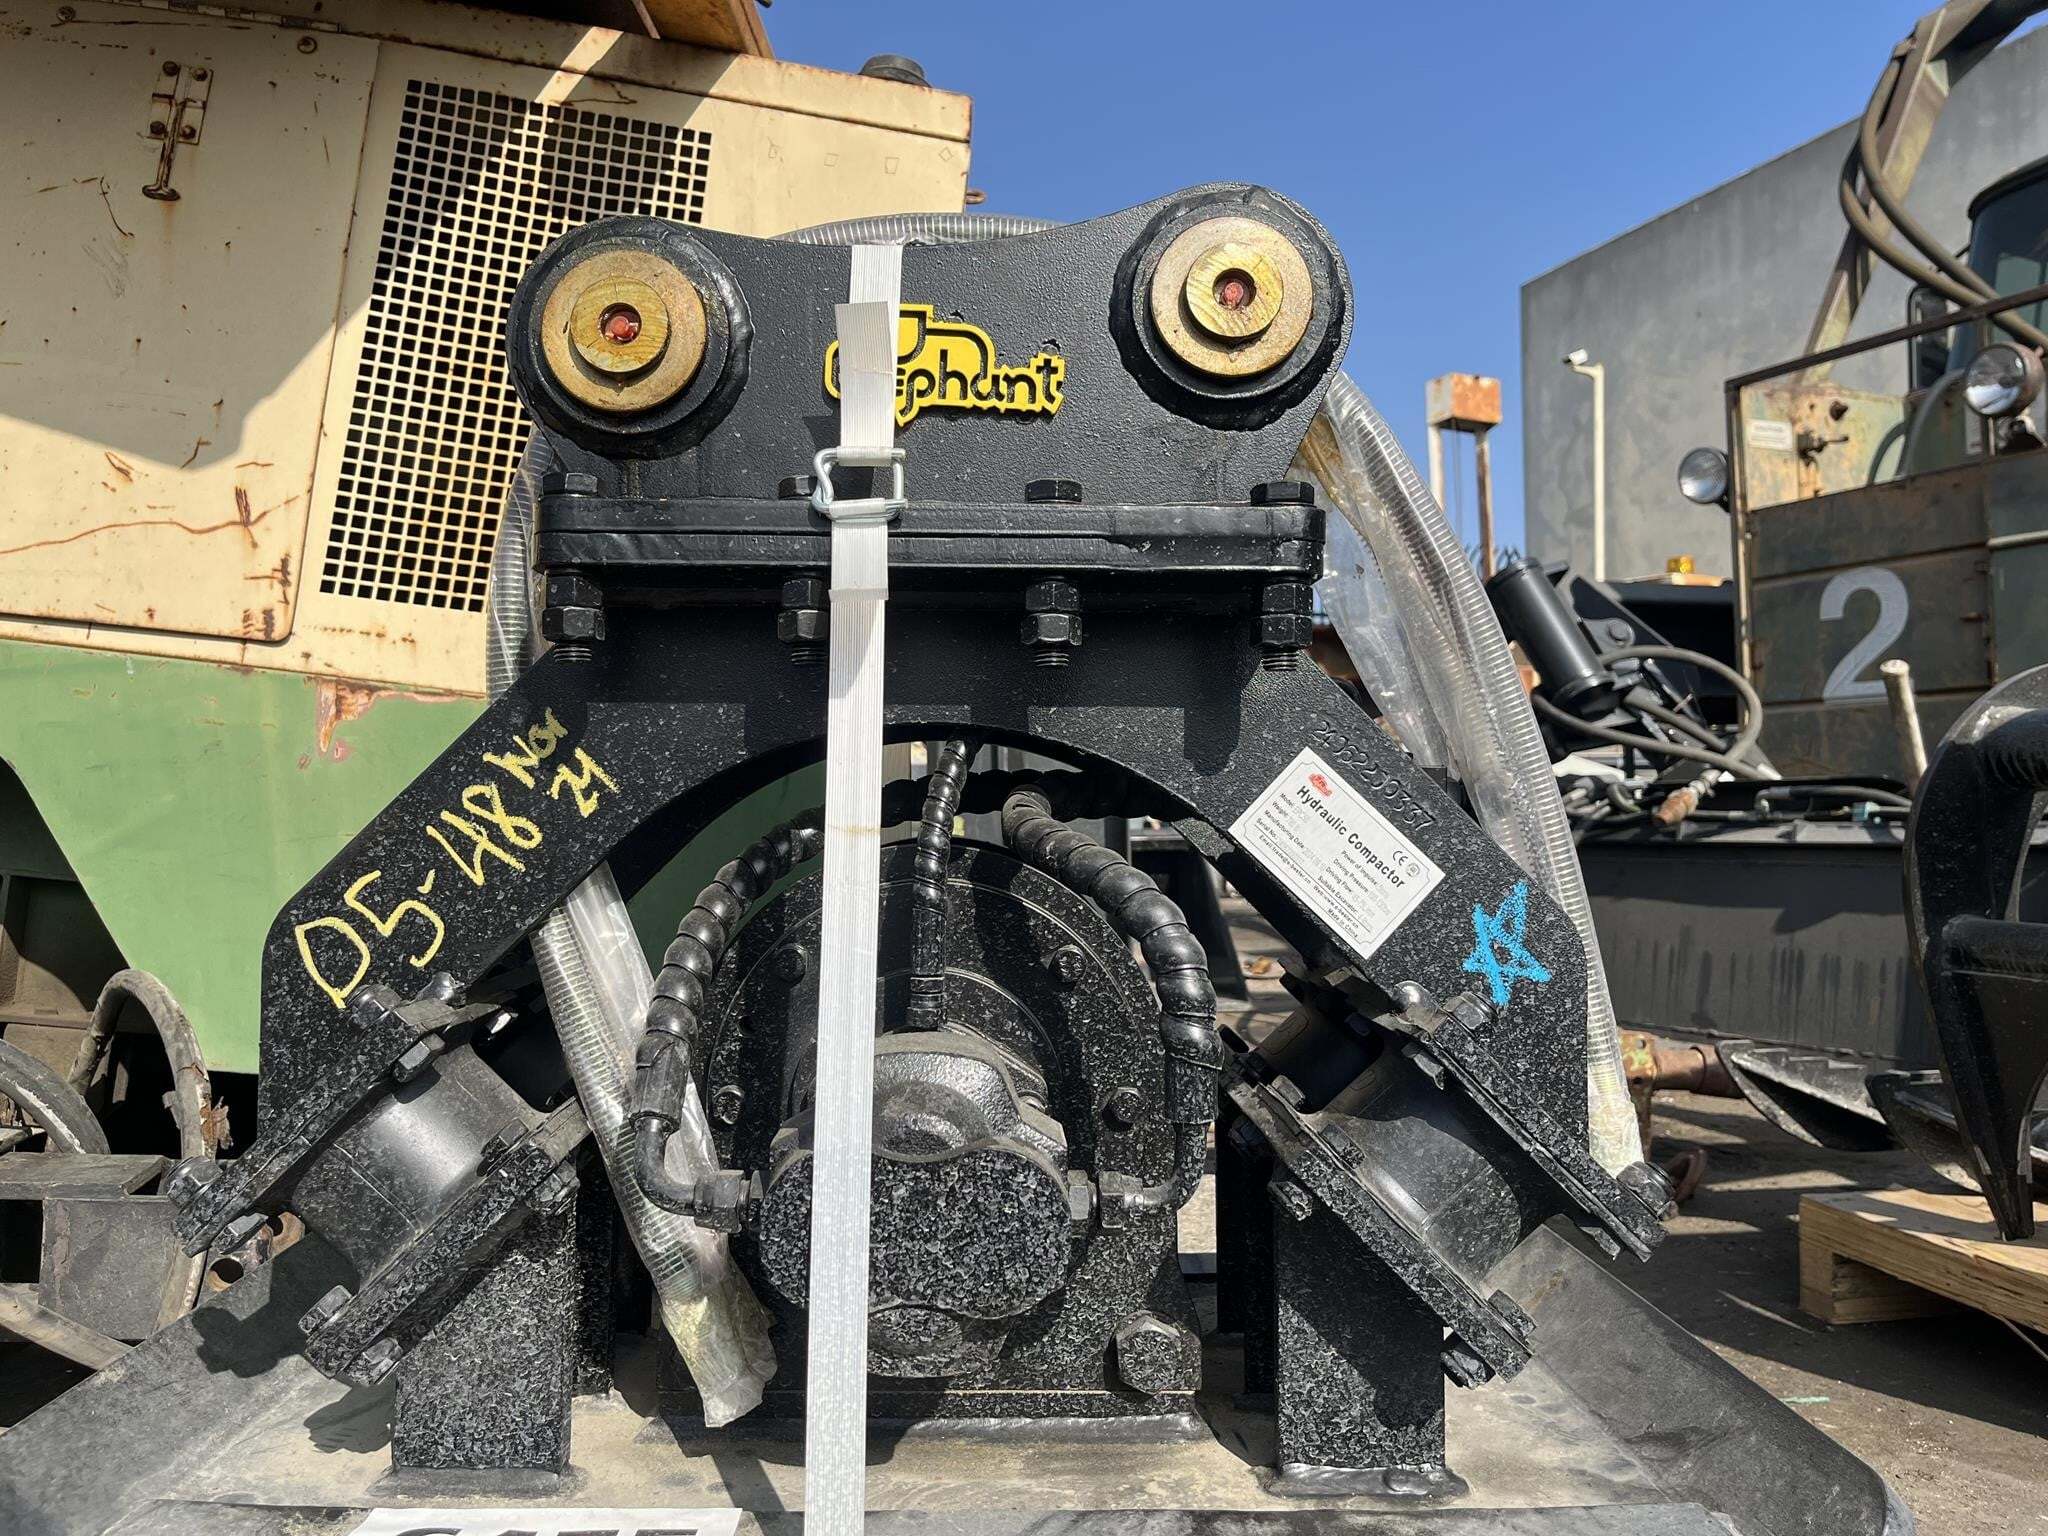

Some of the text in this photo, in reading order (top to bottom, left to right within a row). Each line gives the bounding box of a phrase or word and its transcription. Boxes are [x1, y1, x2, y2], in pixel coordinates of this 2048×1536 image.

[1819, 565, 1909, 704] 2
[1296, 785, 1348, 836] Hydraulic
[1347, 833, 1406, 889] Compactor
